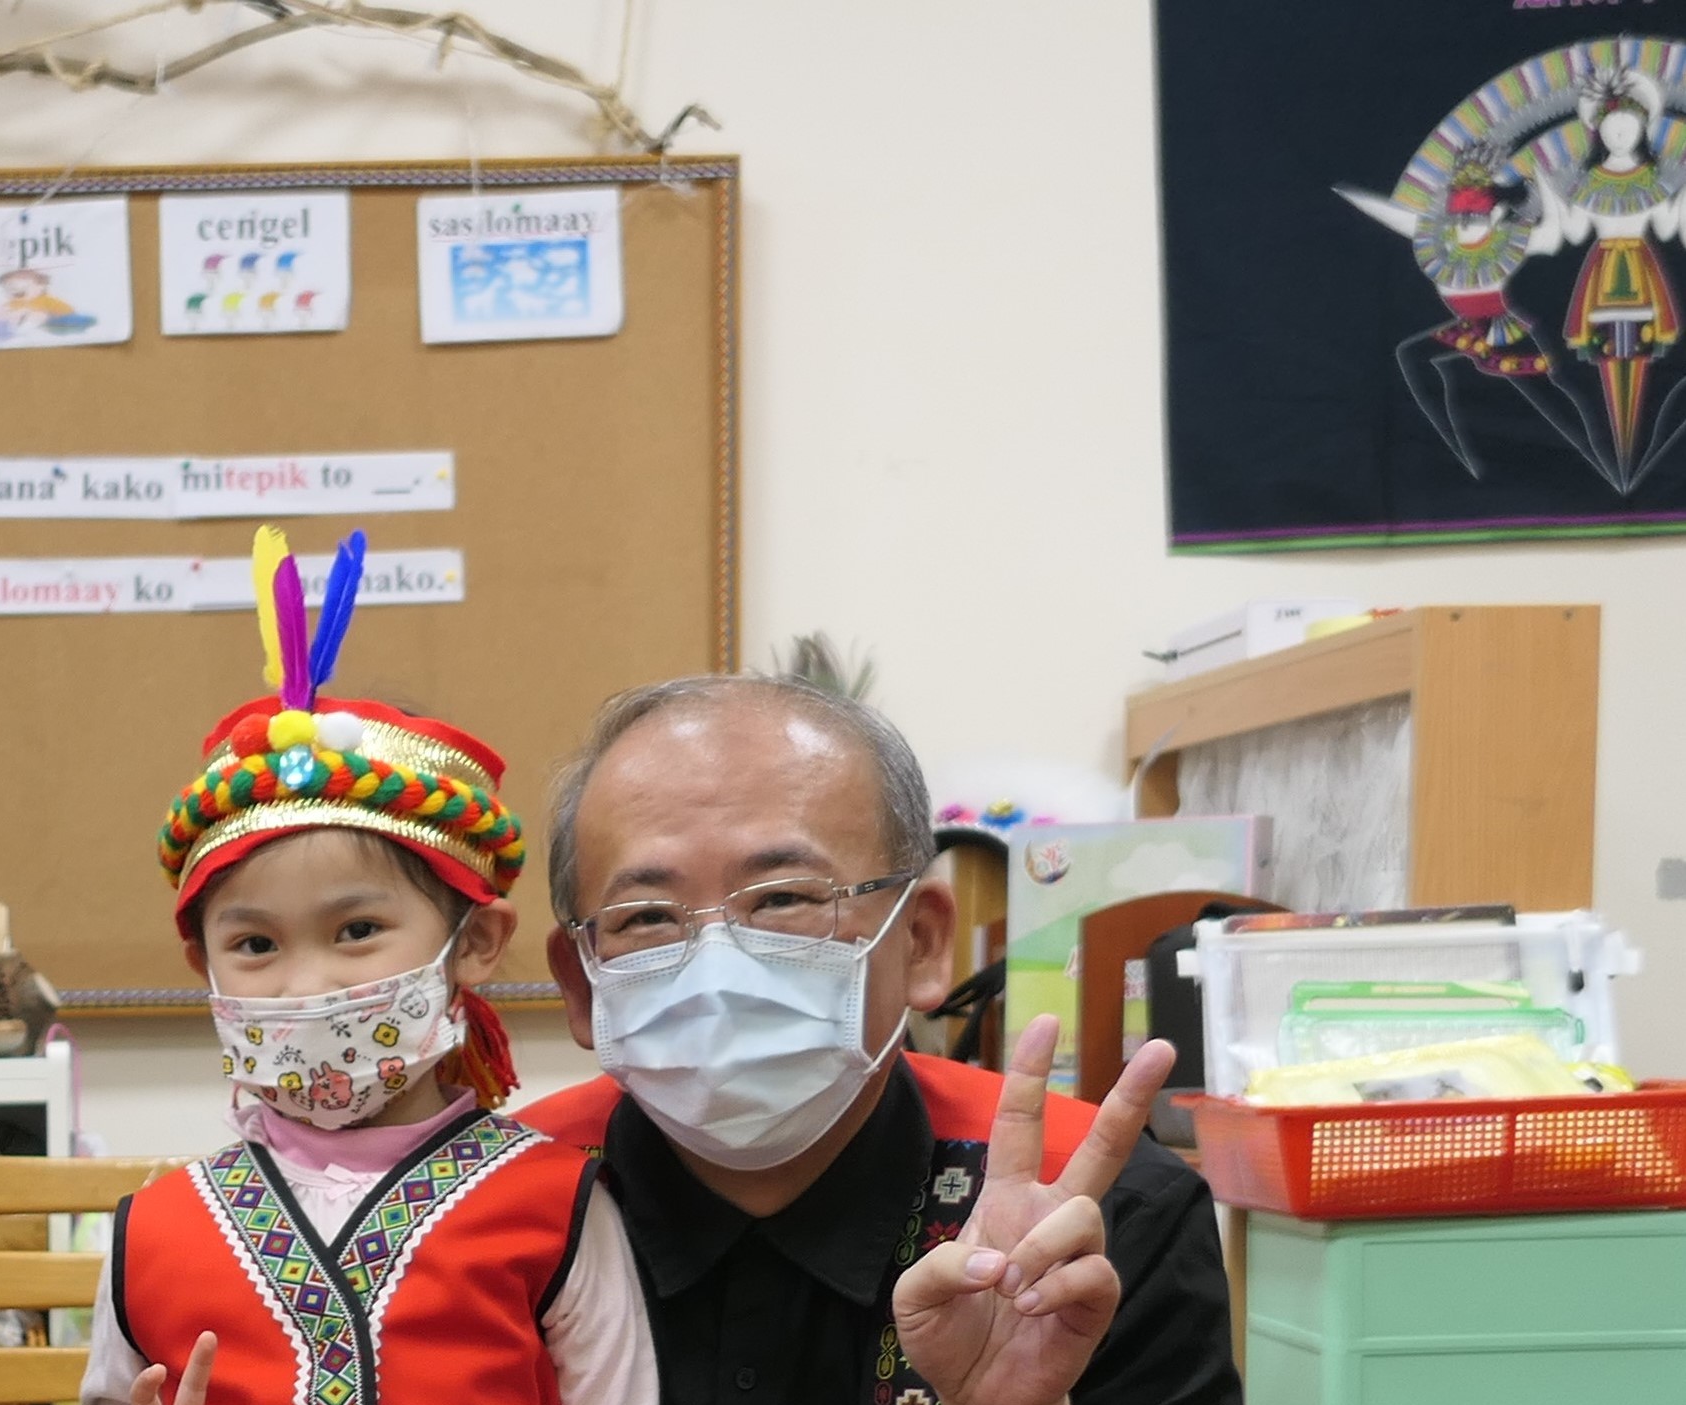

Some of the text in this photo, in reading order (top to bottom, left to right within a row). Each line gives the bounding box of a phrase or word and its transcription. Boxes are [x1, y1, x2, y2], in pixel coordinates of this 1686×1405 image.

[427, 207, 598, 241] saslomaay
[81, 472, 164, 501] kako
[320, 463, 353, 487] to
[133, 573, 174, 602] ko
